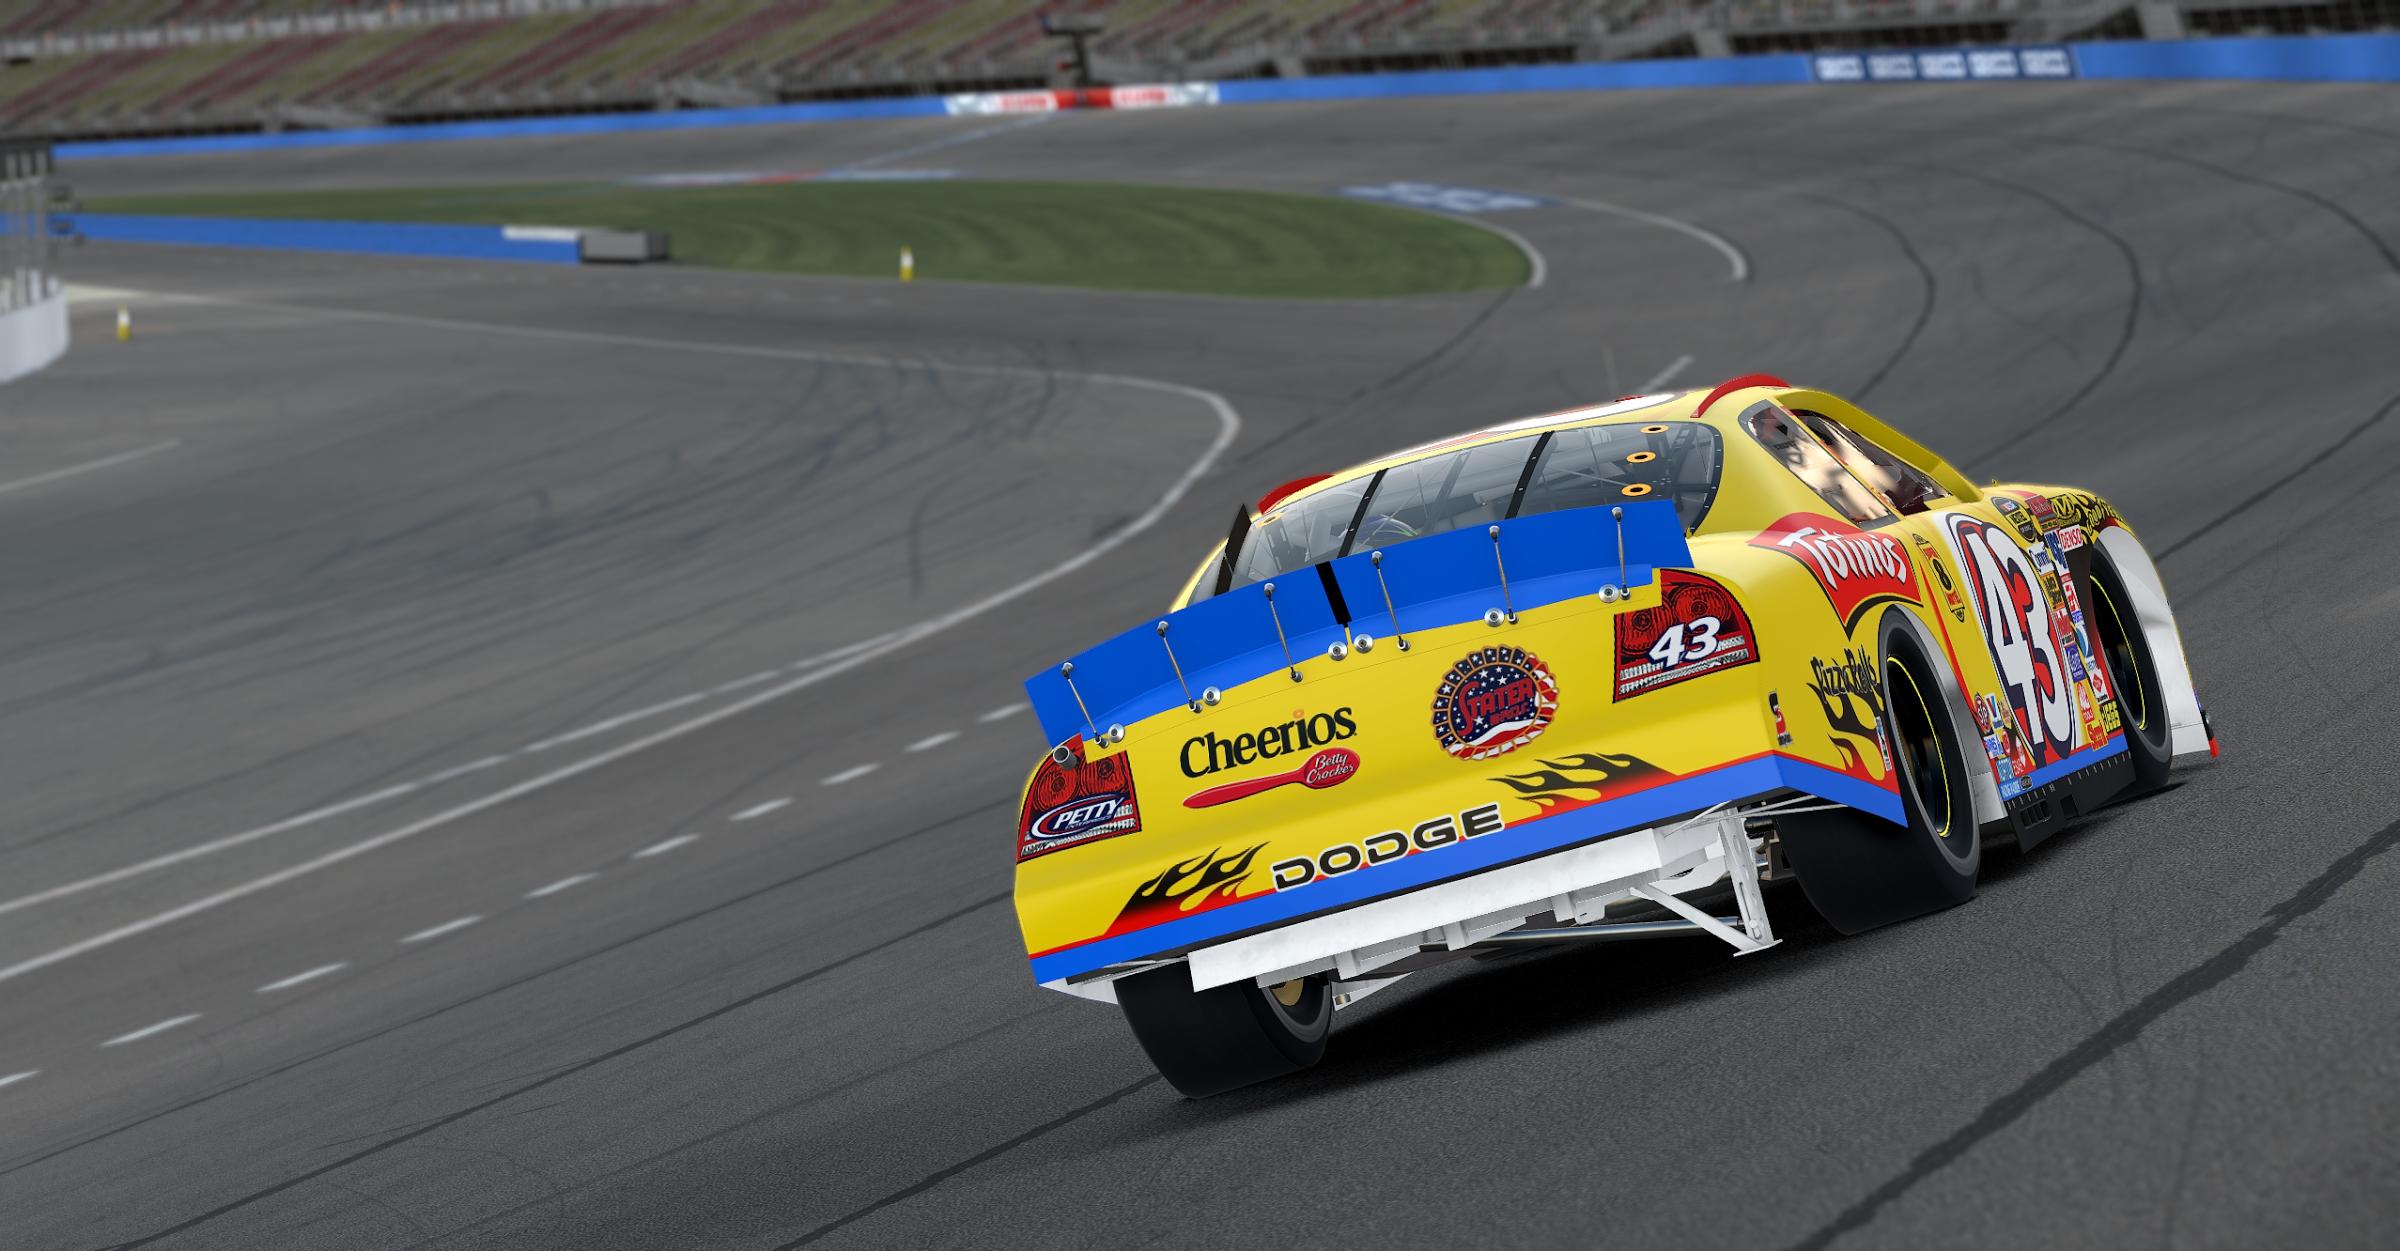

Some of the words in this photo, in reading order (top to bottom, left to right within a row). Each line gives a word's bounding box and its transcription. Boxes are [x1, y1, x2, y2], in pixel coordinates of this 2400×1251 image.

[2059, 528, 2082, 550] DENSO
[1649, 615, 1722, 668] 43
[1963, 524, 2074, 752] 43
[1457, 678, 1534, 737] STATER
[1180, 707, 1357, 778] Cheerios
[1315, 753, 1348, 770] Betty
[1306, 763, 1355, 784] Crocker
[1053, 797, 1125, 830] PETTY
[1272, 803, 1504, 891] DODGE
